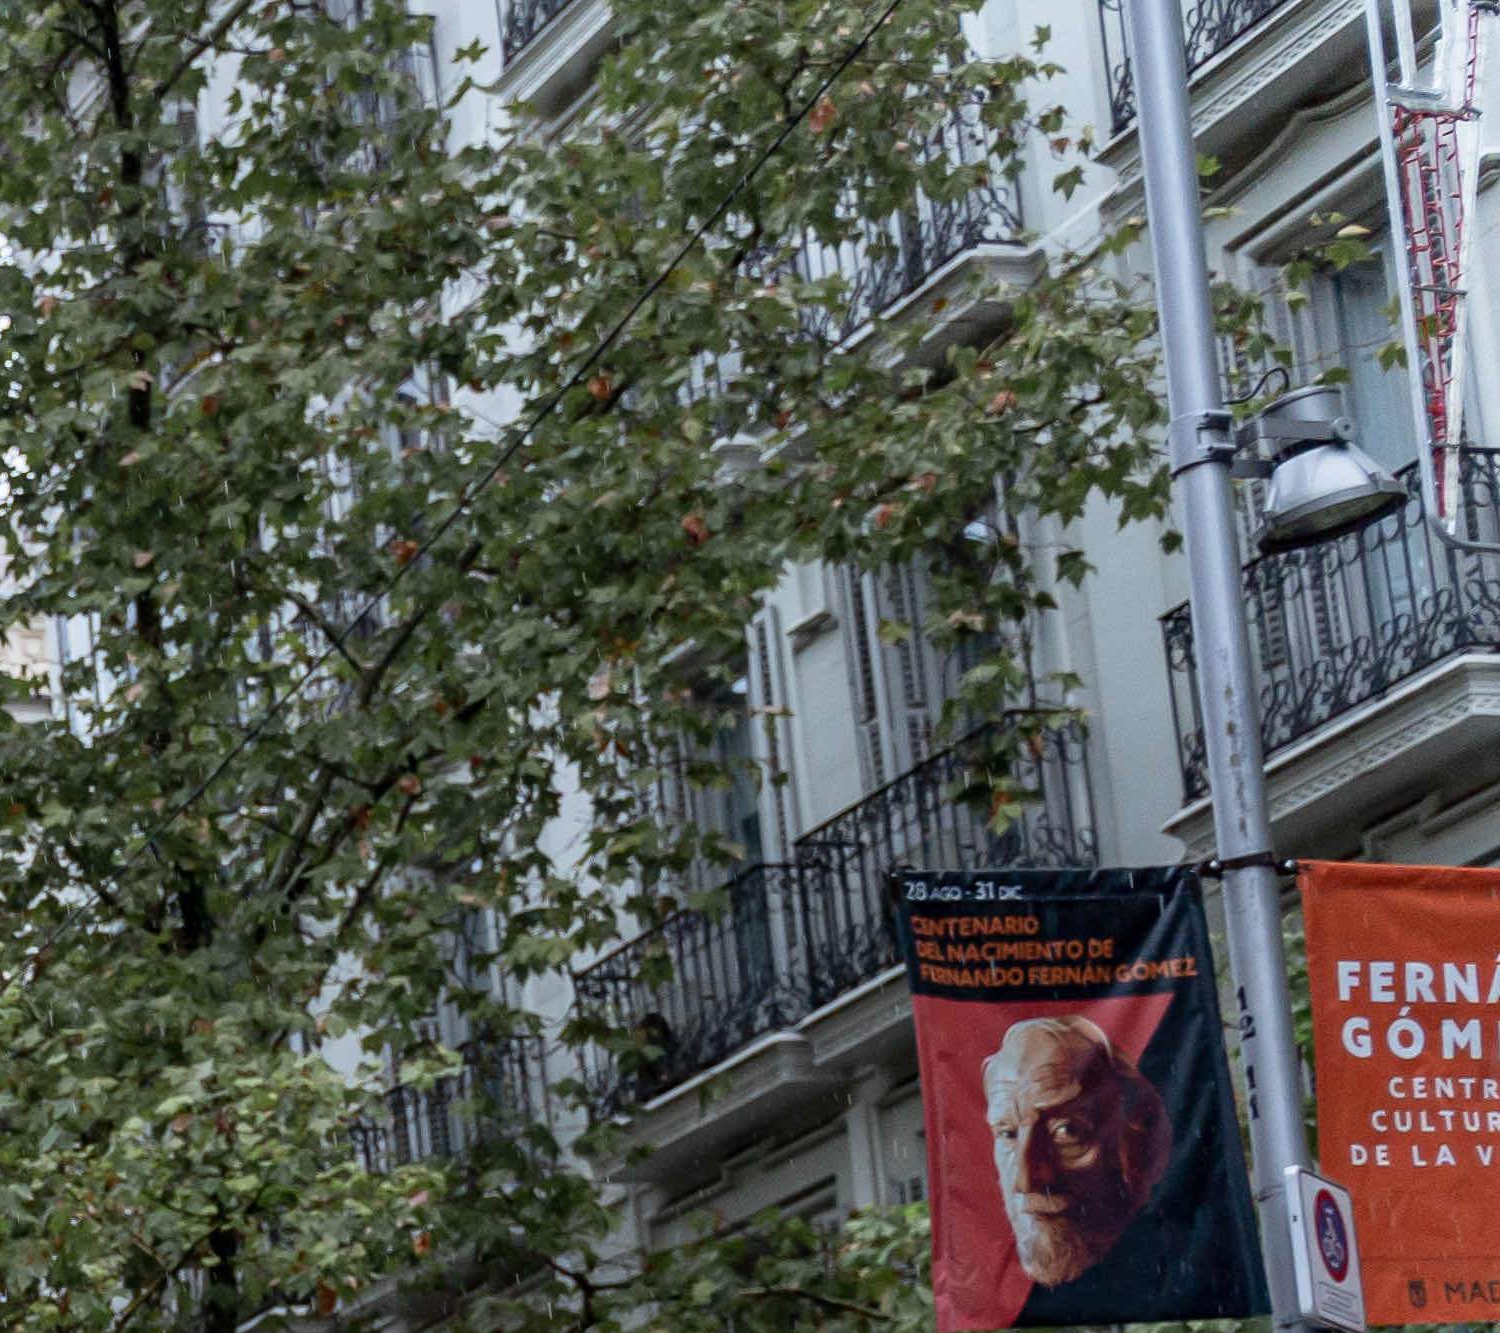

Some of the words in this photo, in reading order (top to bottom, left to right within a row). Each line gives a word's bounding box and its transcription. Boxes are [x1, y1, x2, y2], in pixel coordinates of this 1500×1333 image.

[974, 880, 994, 900] 31
[910, 915, 1040, 937] CENTENARIO
[915, 940, 944, 961] DEL
[946, 940, 1083, 961] NACIMIENTO
[1087, 937, 1115, 959] DE
[920, 962, 1024, 988] FERNANDO
[1341, 1006, 1500, 1059] GÓM
[1389, 1077, 1500, 1098] CENTR
[1371, 1110, 1500, 1132] CULTUR
[1350, 1145, 1391, 1167] DE
[1412, 1145, 1456, 1166] LA
